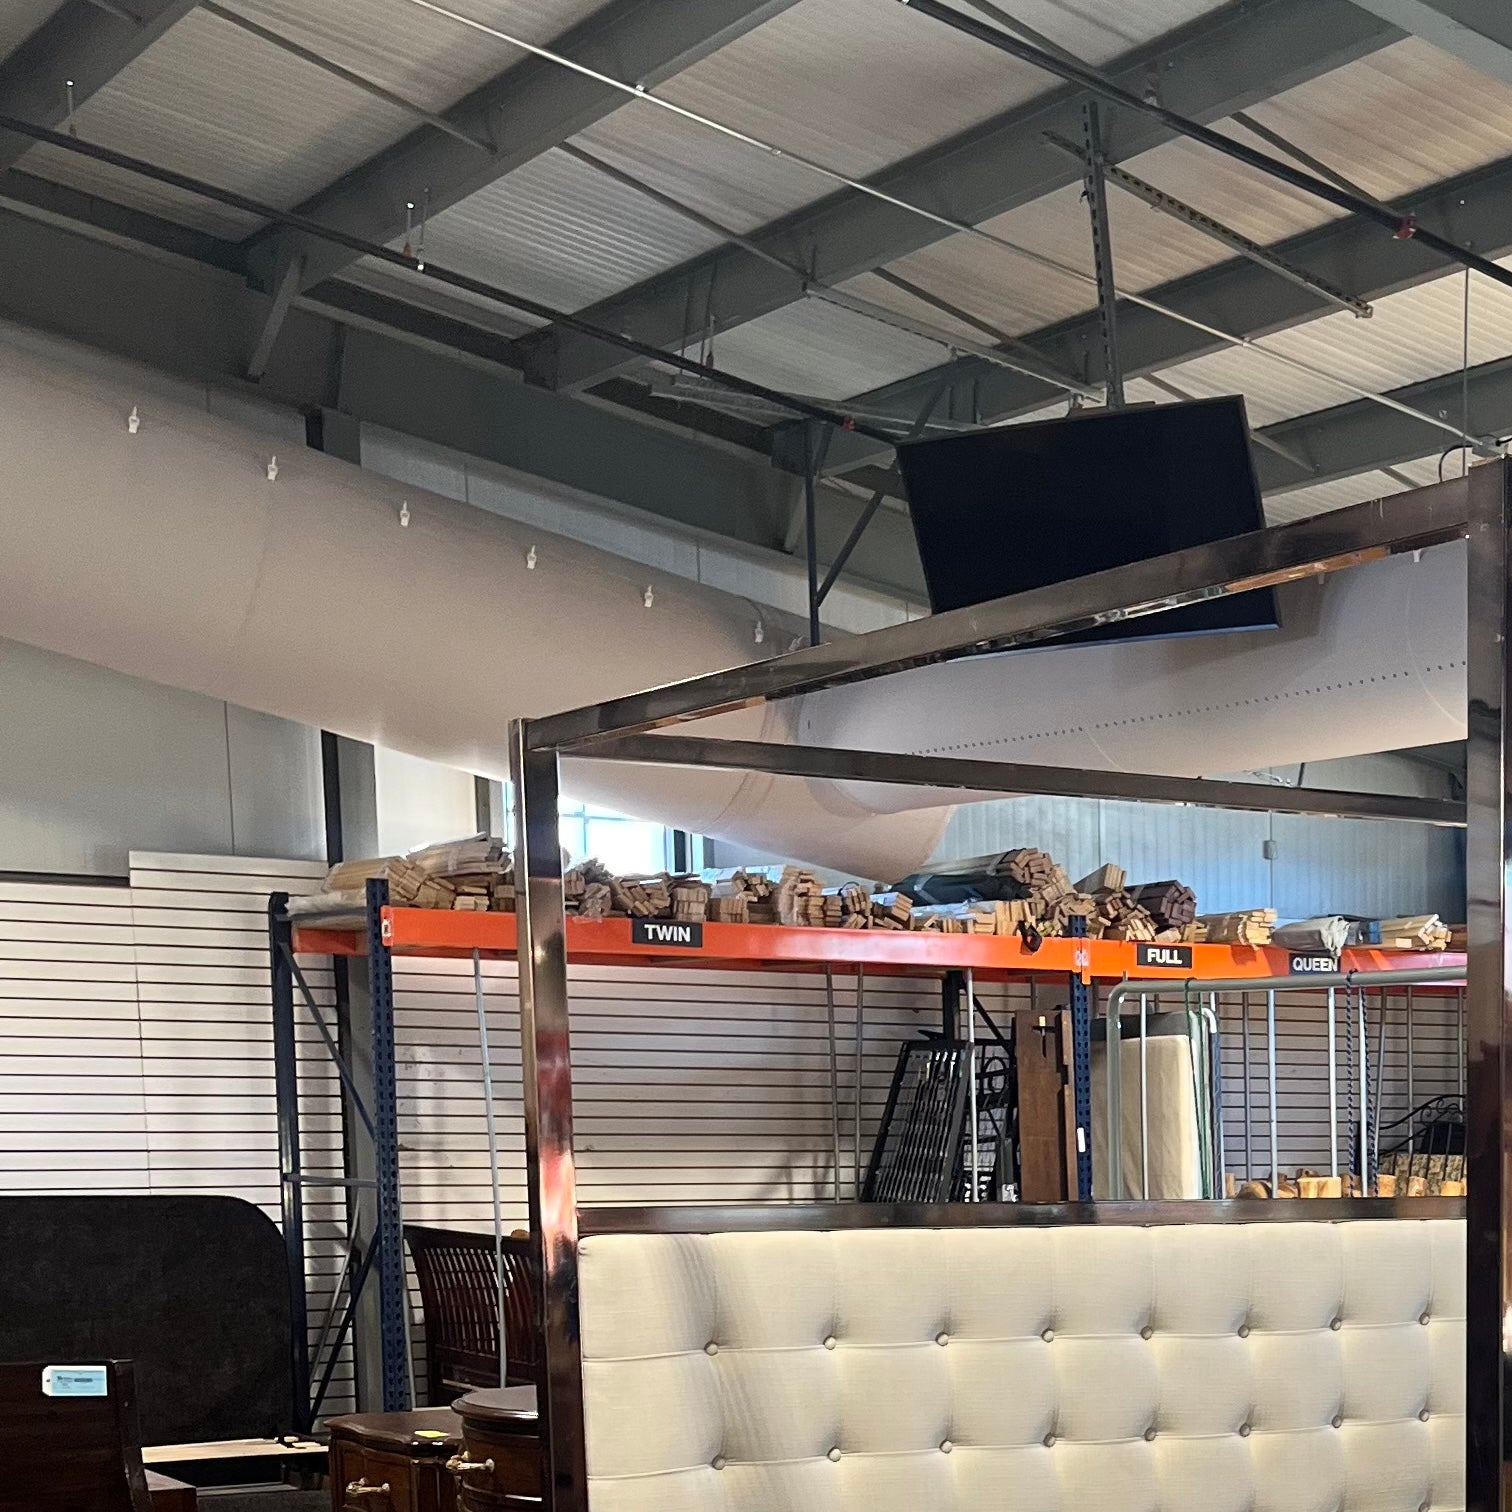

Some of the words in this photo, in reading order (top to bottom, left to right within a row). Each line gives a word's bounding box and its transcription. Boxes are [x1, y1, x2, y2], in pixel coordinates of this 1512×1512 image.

[644, 924, 691, 942] TWIN
[1147, 948, 1183, 965] FULL
[1292, 957, 1338, 972] QUEEN
